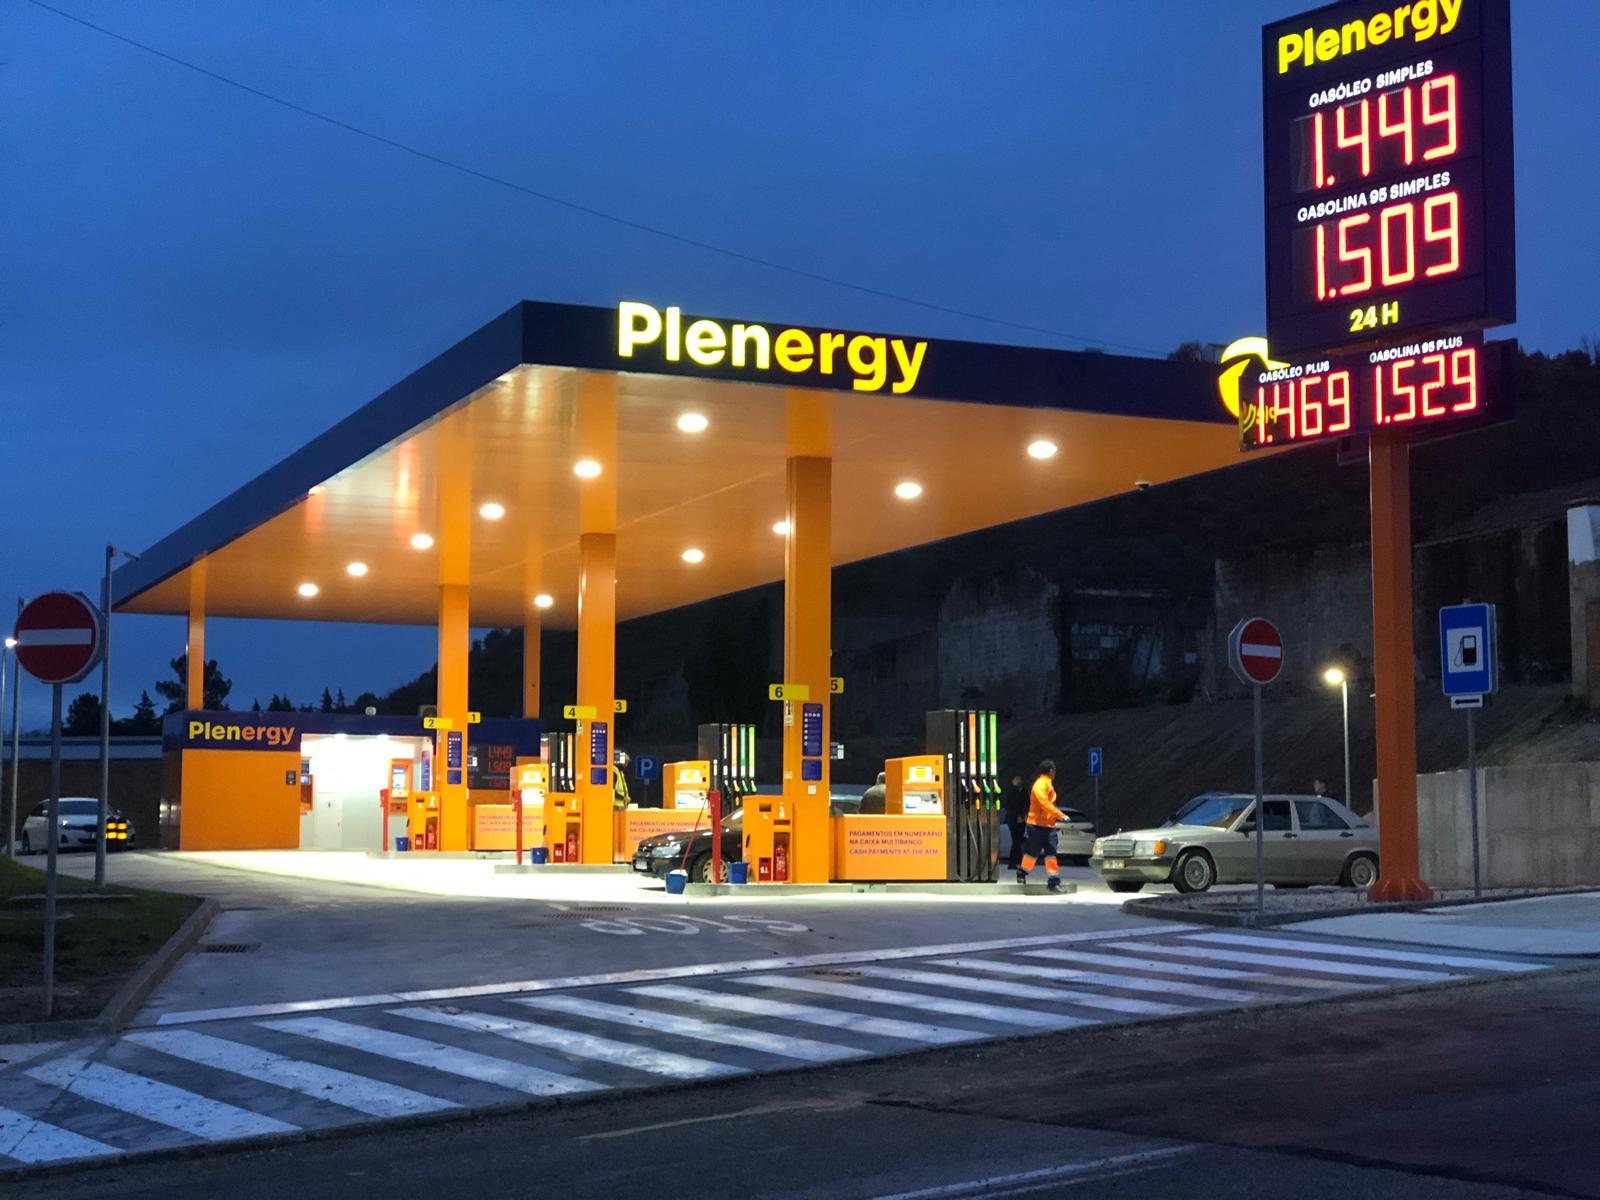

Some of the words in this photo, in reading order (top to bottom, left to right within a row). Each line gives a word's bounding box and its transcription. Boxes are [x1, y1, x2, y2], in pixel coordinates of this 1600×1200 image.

[1278, 0, 1463, 74] Plenergy
[1309, 78, 1371, 107] GASÓLEO
[1376, 60, 1433, 89] SIMPLES
[1314, 74, 1457, 189] 1.449
[1297, 193, 1367, 222] GASOLINA
[1370, 189, 1388, 204] 95
[1390, 172, 1450, 199] SIMPLES
[1316, 191, 1459, 300] 1.509
[1350, 305, 1377, 332] 24
[1381, 301, 1399, 325] H
[618, 301, 928, 394] Plenergy
[1369, 345, 1420, 363] GASOLINA
[1421, 343, 1435, 354] 95
[1437, 336, 1462, 351] PLUS
[1259, 365, 1302, 383] GASÓLEO
[1305, 360, 1330, 376] PLUS
[1375, 348, 1477, 425] 1.529
[1259, 371, 1350, 443] 1.469
[775, 686, 783, 698] 6
[830, 679, 838, 691] 5
[471, 713, 476, 722] 1
[568, 707, 576, 717] 4
[615, 701, 622, 711] 3
[188, 721, 295, 745] Plenergy
[428, 718, 434, 727] 2
[641, 758, 653, 776] P
[1090, 752, 1098, 773] P
[580, 914, 809, 937] STOP
